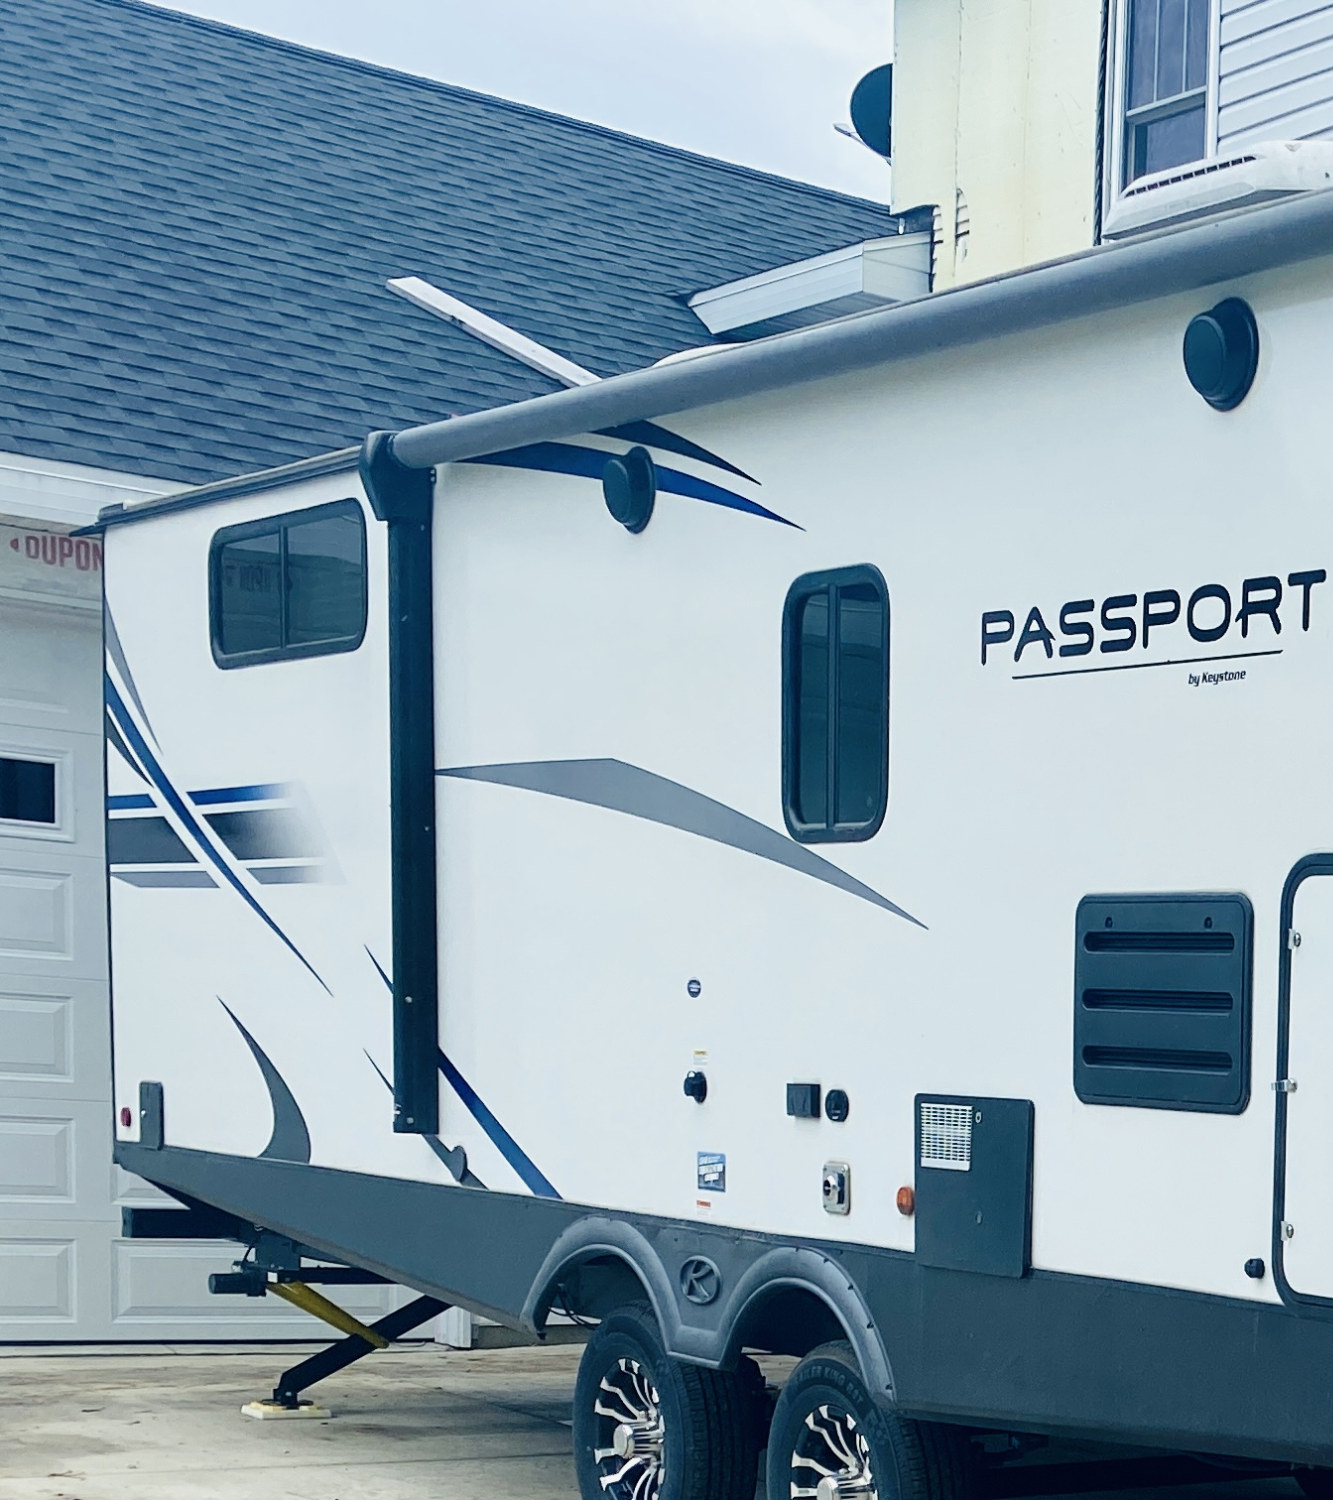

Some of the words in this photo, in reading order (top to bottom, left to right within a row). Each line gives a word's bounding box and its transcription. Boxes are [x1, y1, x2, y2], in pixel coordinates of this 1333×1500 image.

[981, 569, 1326, 666] PASSPORT
[1188, 673, 1200, 687] by
[1202, 670, 1246, 685] Keystone
